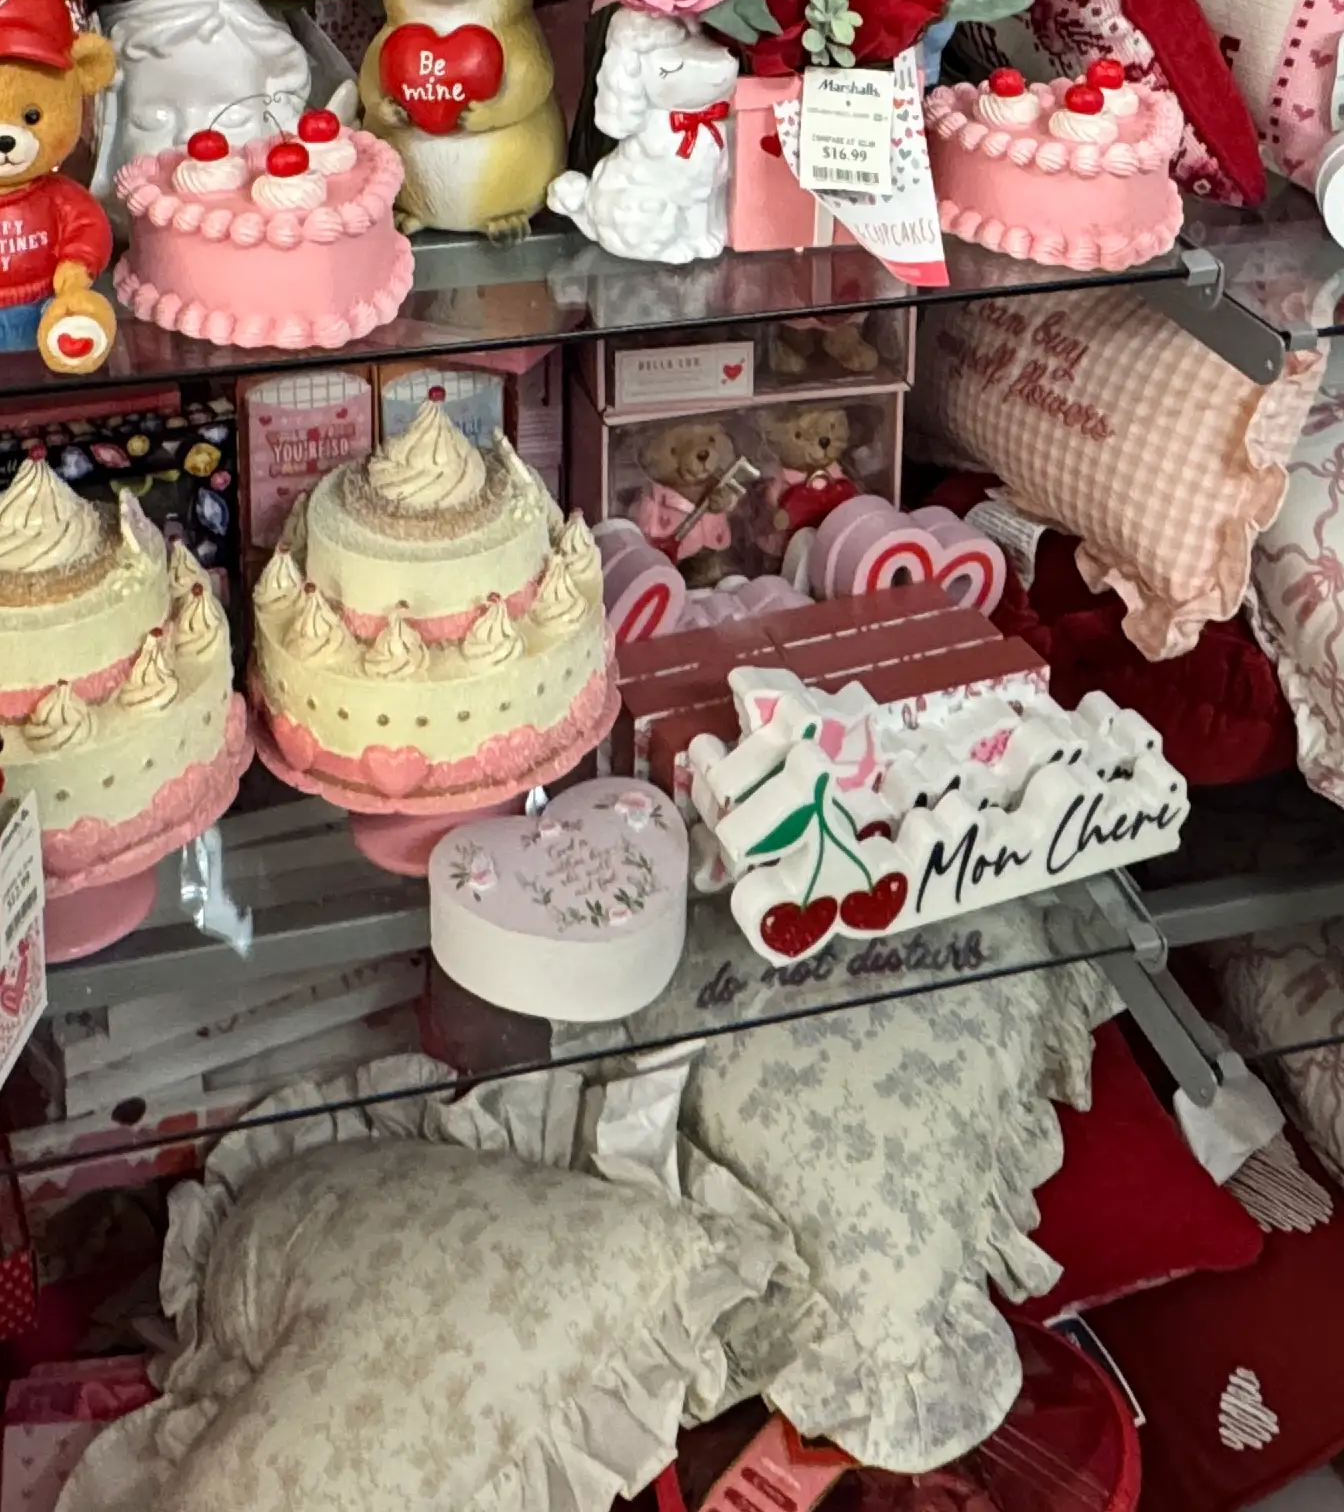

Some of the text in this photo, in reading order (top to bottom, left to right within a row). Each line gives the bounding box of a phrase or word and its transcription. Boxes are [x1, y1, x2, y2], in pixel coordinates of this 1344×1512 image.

[419, 50, 446, 76] Be
[401, 76, 466, 101] mine
[818, 78, 881, 98] Marshalls
[822, 145, 868, 162] $16.99
[1003, 359, 1116, 441] flowers
[916, 782, 1183, 914] Mon Cheri
[697, 930, 989, 1009] do not disturb
